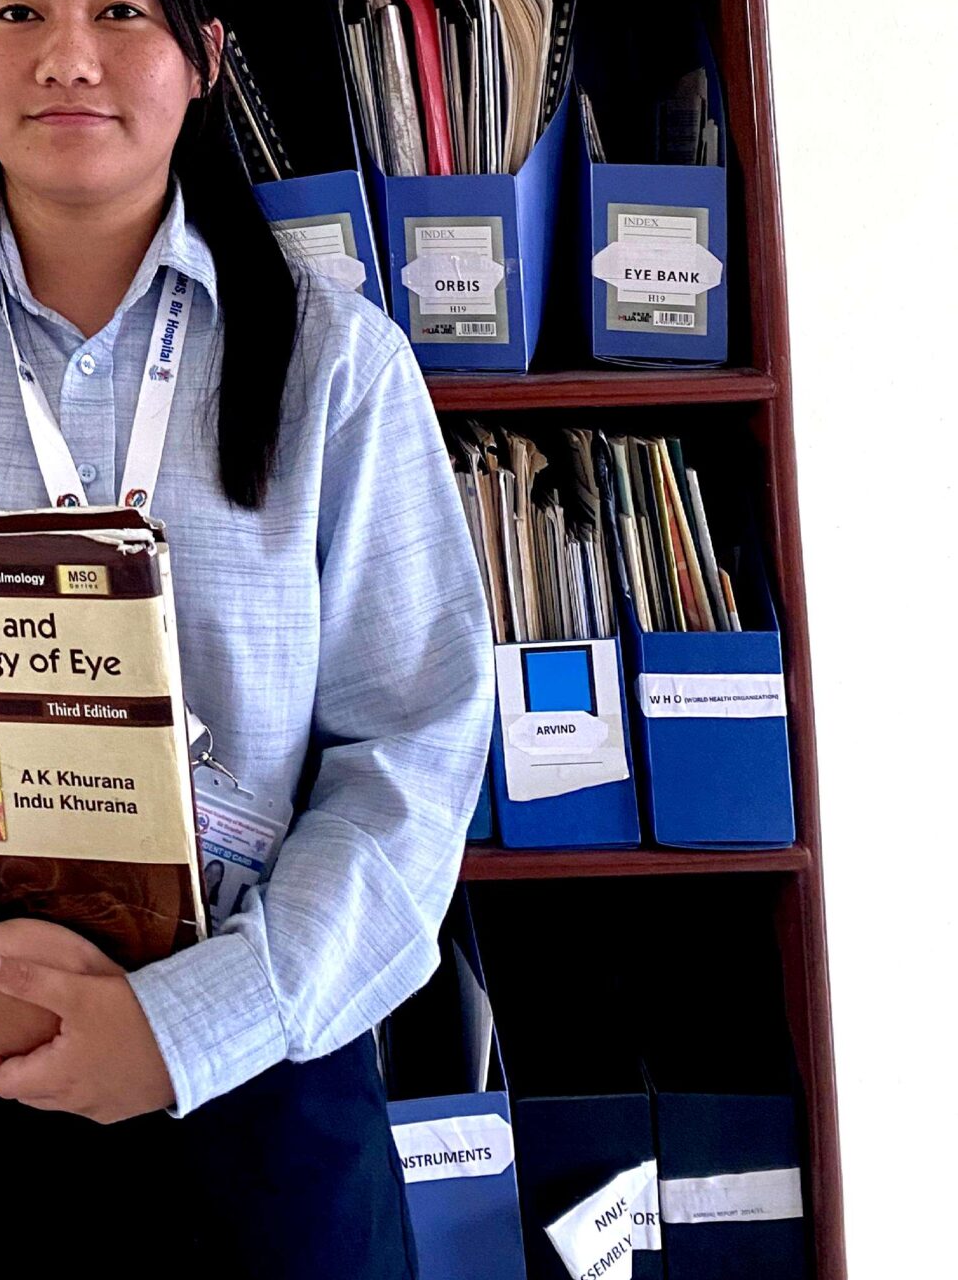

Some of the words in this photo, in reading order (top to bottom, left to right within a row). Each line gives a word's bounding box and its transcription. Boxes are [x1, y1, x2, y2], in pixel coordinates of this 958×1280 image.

[624, 217, 658, 226] INDEX
[422, 230, 455, 238] INDEX
[625, 269, 651, 280] EYE
[658, 271, 699, 283] BANK
[435, 280, 480, 291] ORBIS
[170, 300, 183, 317] Bir
[159, 319, 179, 363] Hospital
[68, 571, 97, 582] MSO
[3, 613, 57, 639] and
[29, 648, 60, 675] of
[70, 648, 121, 680] Eye
[674, 695, 681, 703] O
[47, 702, 80, 716] Third
[84, 705, 128, 719] Edition
[537, 724, 576, 736] ARVIND
[21, 769, 34, 784] A
[37, 770, 51, 785] K
[57, 770, 135, 790] Khurana
[14, 792, 54, 808] Indu
[60, 795, 138, 814] Khurana
